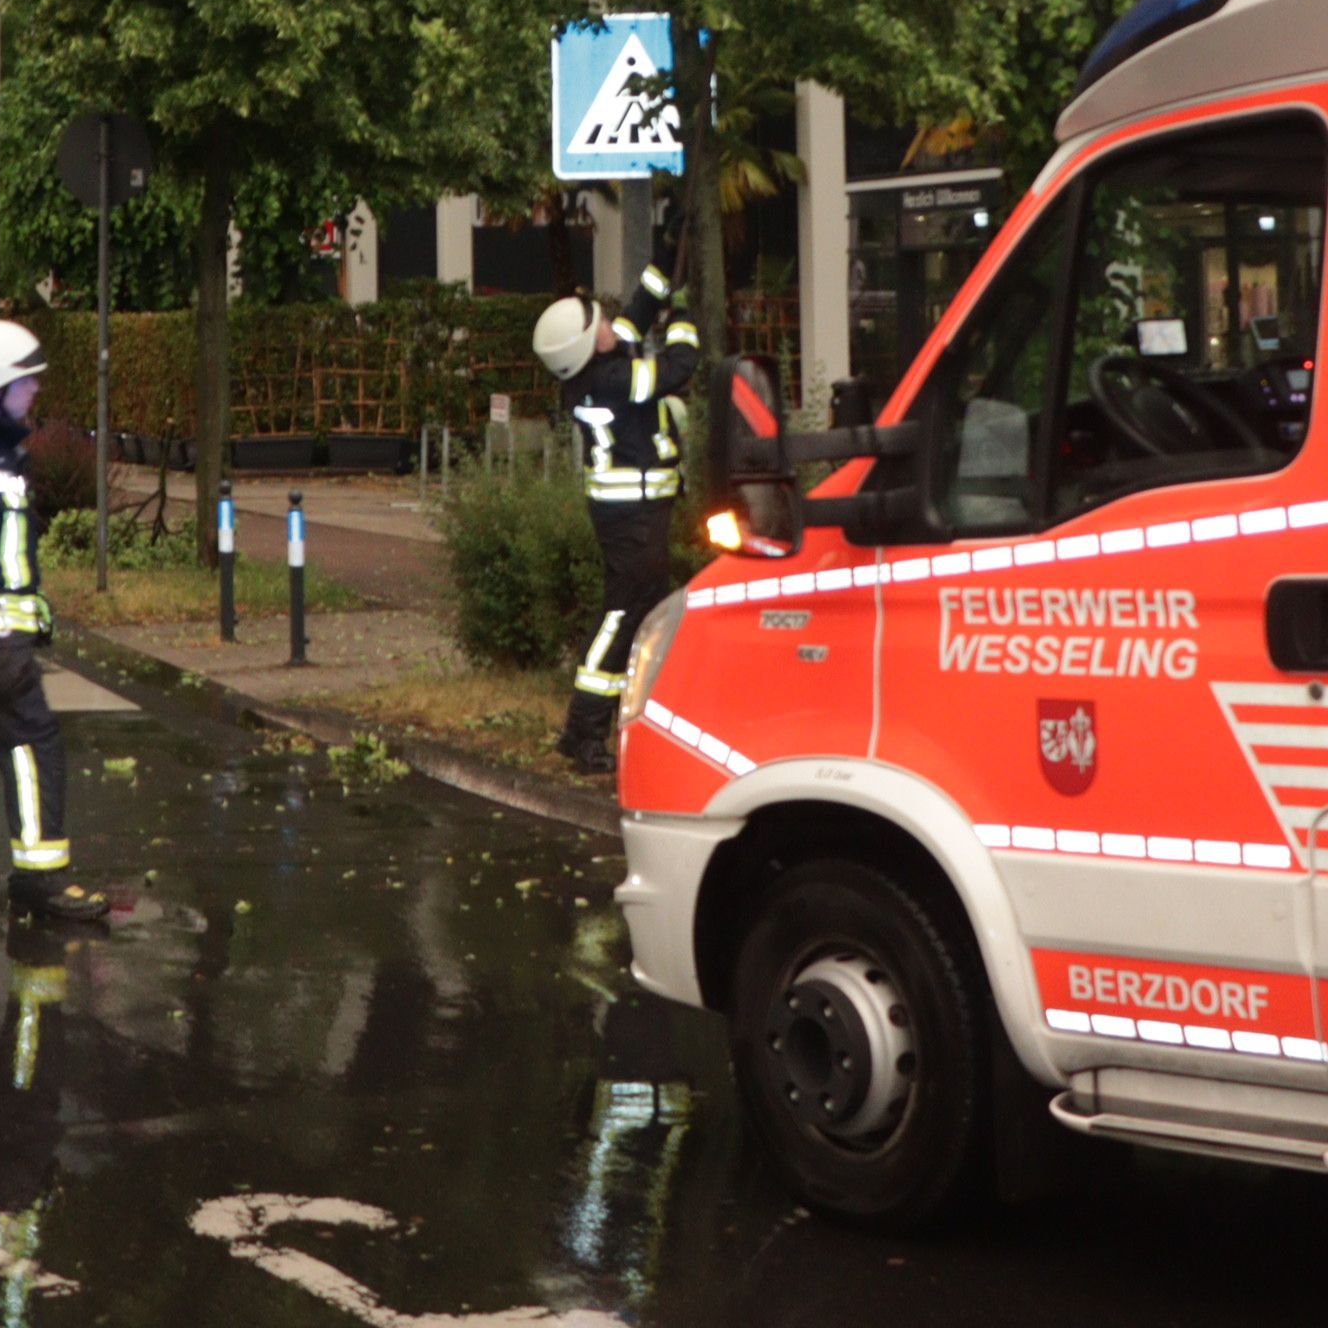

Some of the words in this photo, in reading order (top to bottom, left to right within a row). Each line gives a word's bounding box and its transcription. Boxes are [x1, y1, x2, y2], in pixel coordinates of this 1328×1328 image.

[939, 587, 1200, 629] FEUERWEHR
[939, 633, 1199, 679] WESSELING
[1068, 965, 1269, 1020] BERZDORF
